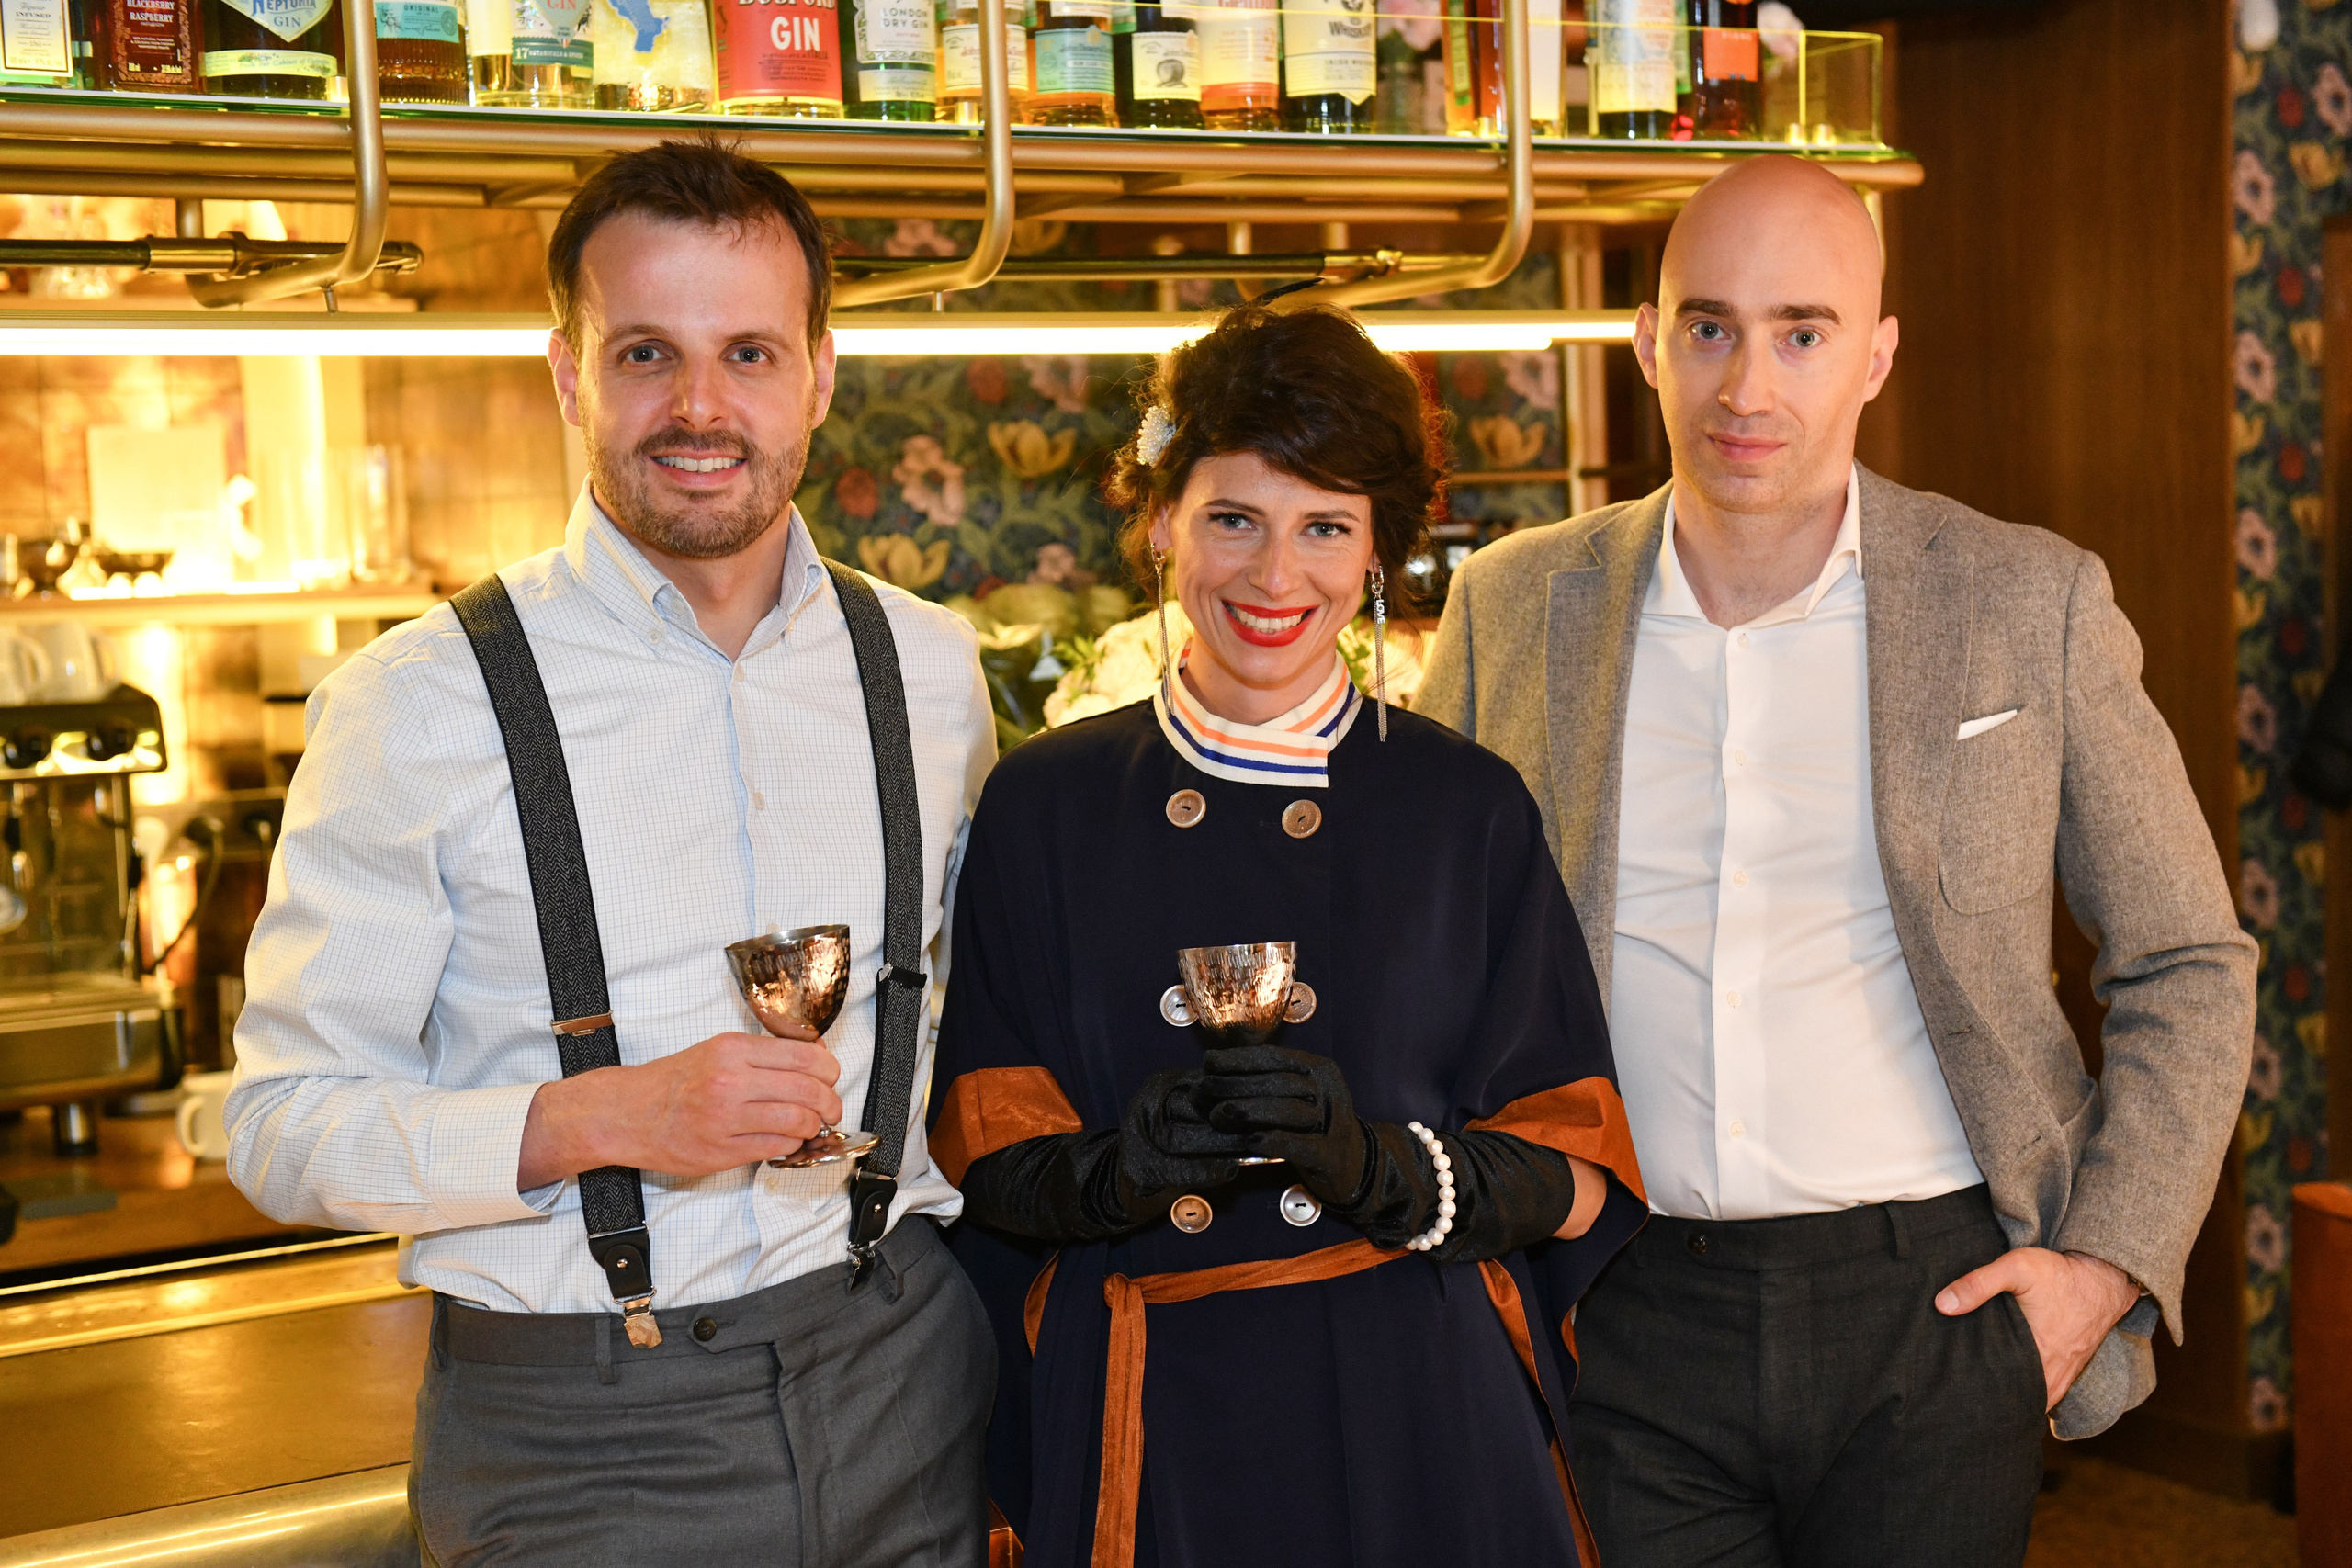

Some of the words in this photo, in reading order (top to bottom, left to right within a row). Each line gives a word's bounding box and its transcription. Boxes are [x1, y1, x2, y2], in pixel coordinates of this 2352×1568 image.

[126, 0, 175, 10] BLACKBERRY
[403, 5, 439, 13] ORIGINAL
[130, 11, 174, 23] RASPBERRY
[883, 7, 928, 17] LONDON
[274, 17, 301, 28] GIN
[883, 18, 907, 28] DRY
[912, 19, 929, 28] GIN
[770, 16, 820, 51] GIN
[514, 47, 530, 59] 17
[1375, 599, 1385, 625] LOVE
